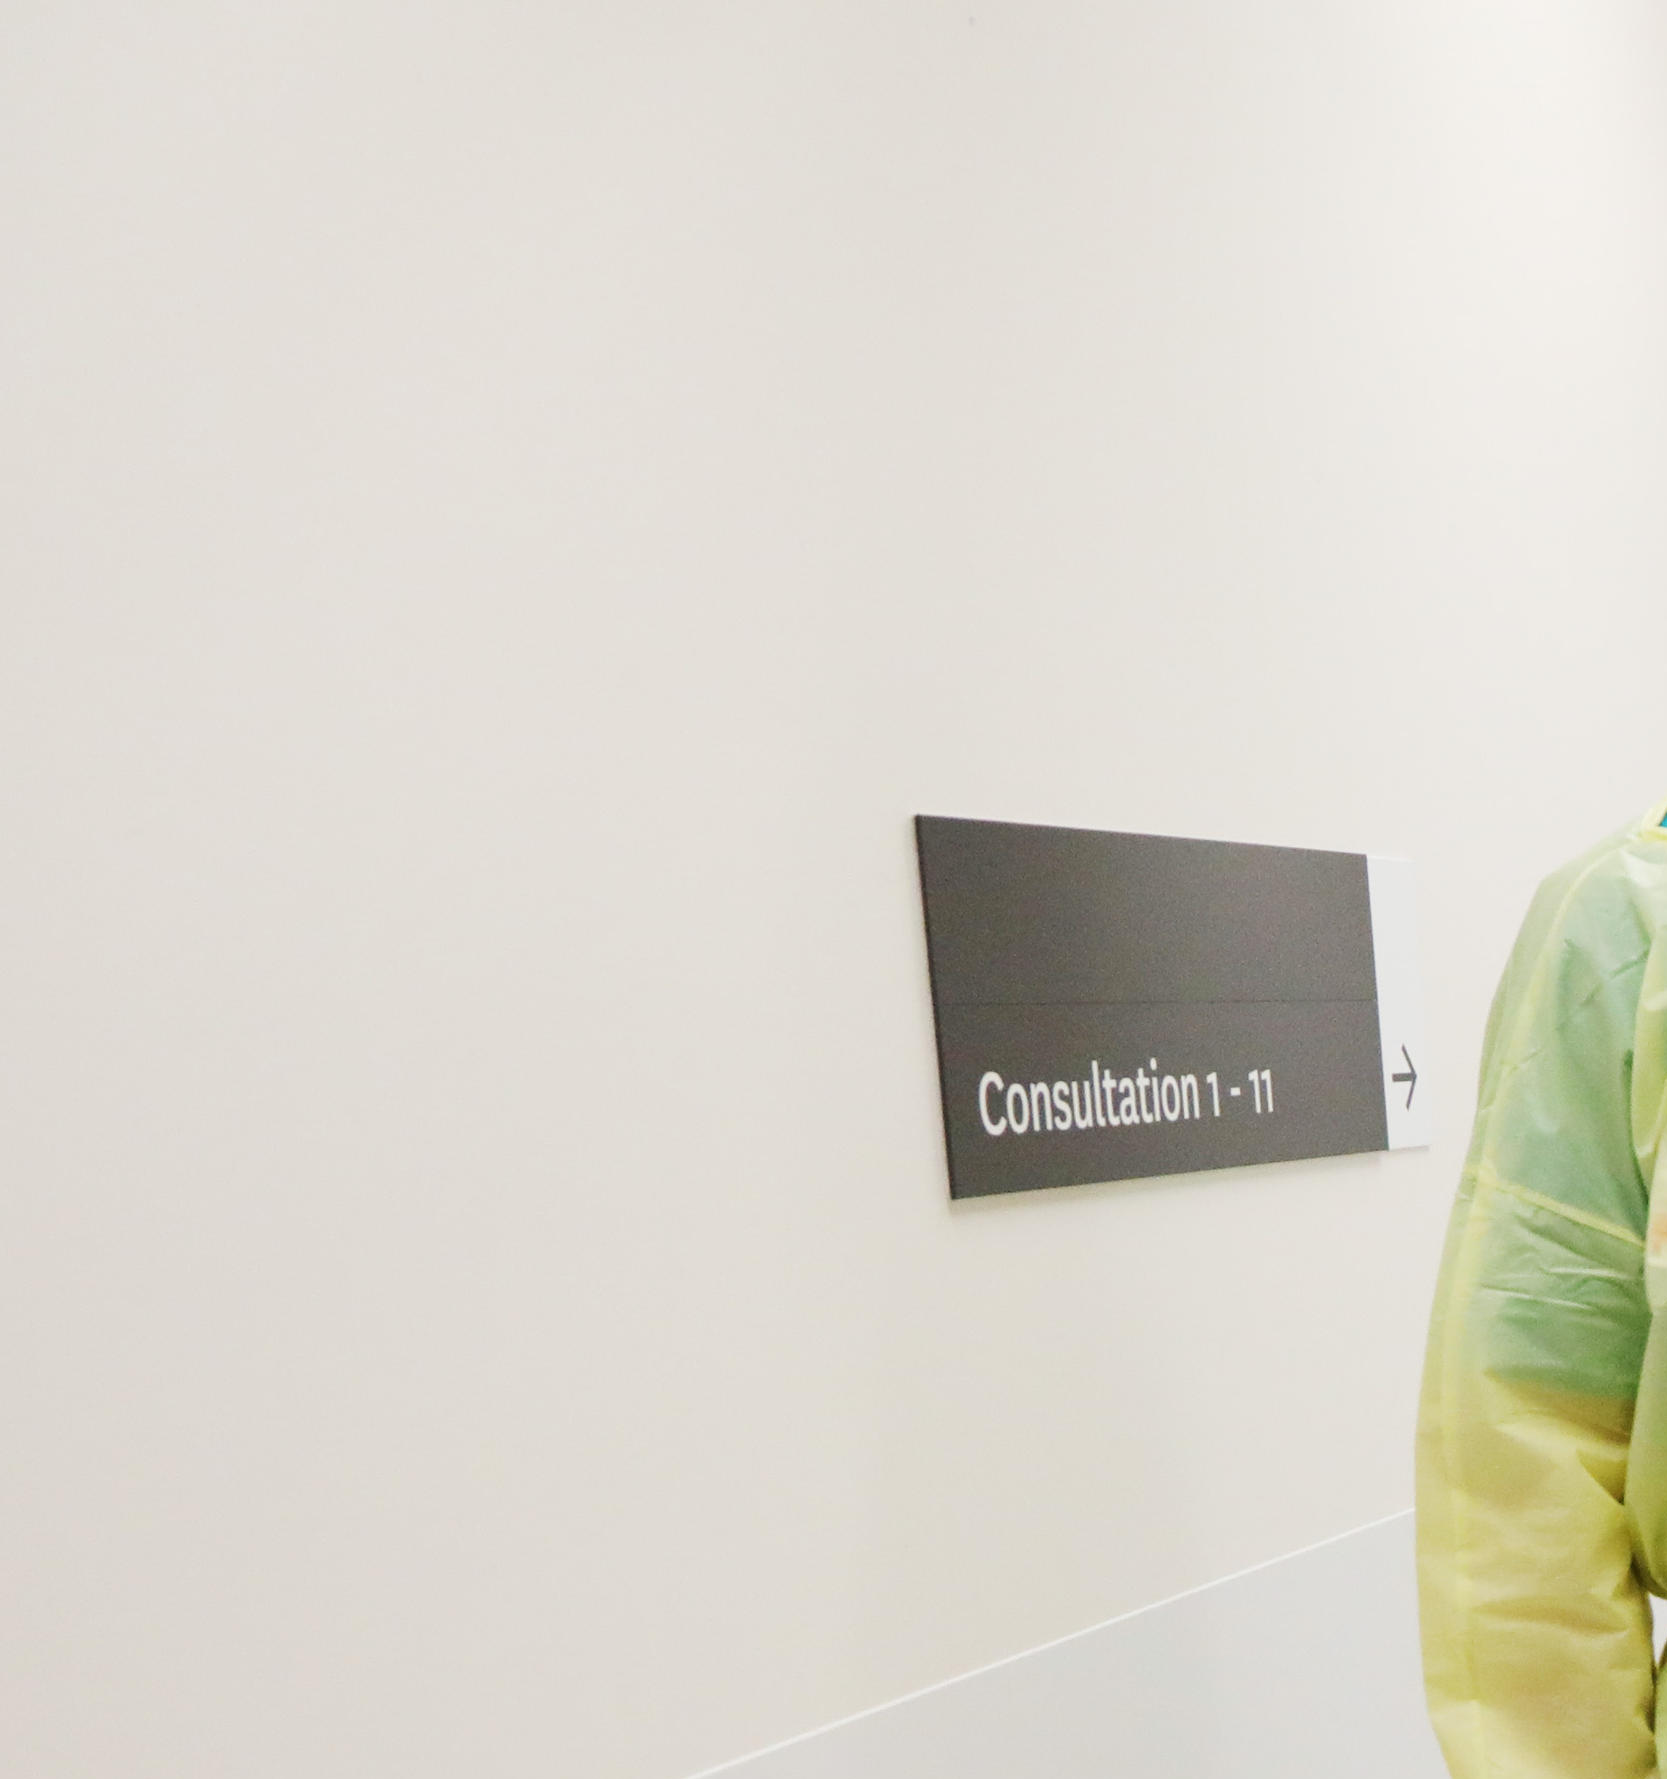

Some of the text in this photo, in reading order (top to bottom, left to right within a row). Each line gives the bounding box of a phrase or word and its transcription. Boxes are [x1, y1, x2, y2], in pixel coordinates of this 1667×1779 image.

[978, 1057, 1200, 1137] Consultation
[1206, 1071, 1221, 1118] 1
[1247, 1069, 1275, 1114] 11
